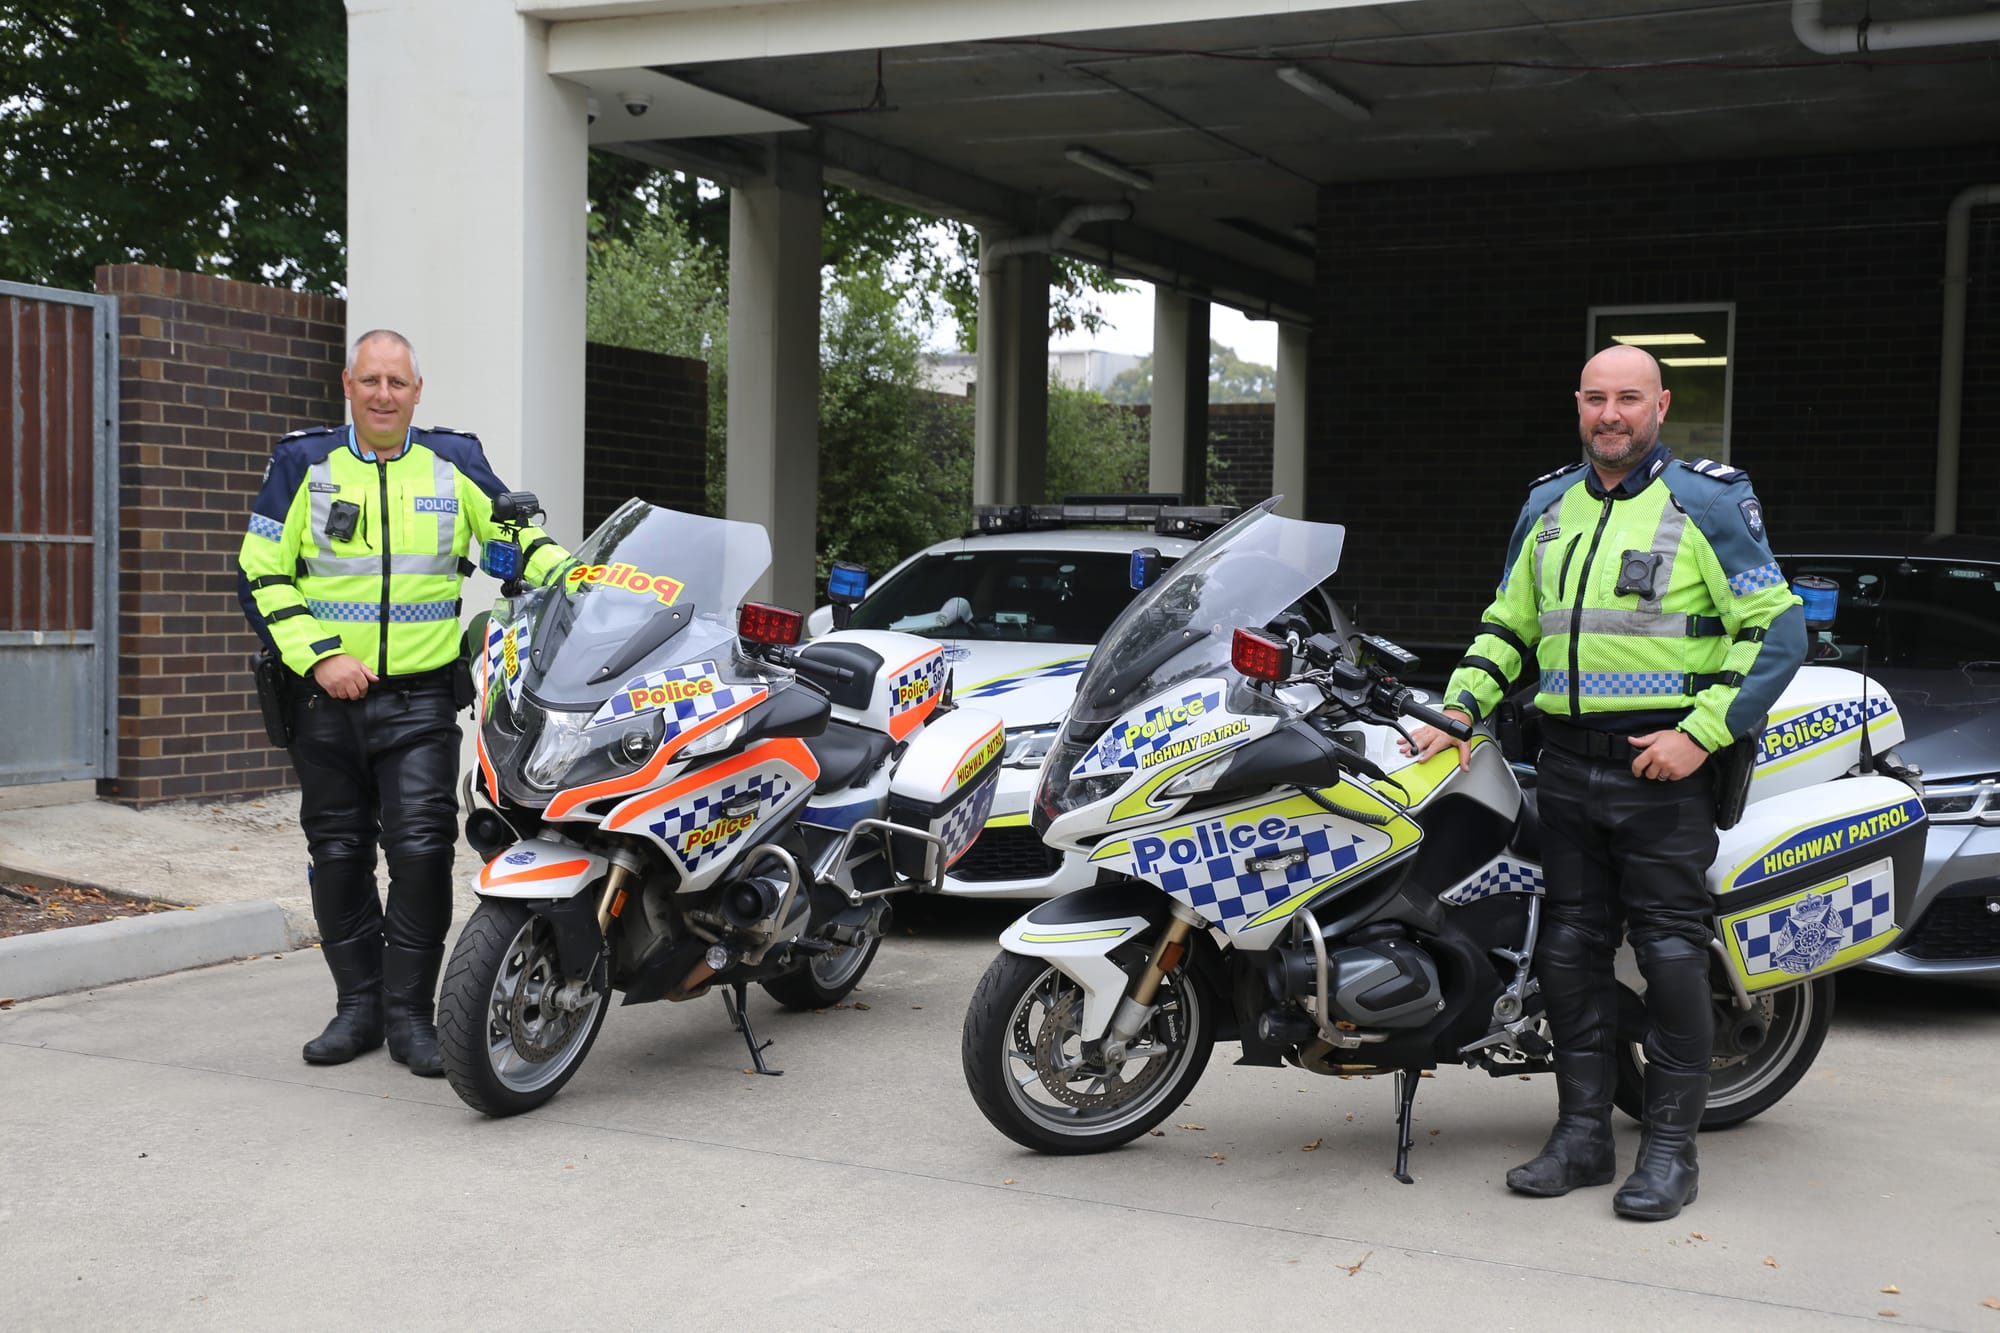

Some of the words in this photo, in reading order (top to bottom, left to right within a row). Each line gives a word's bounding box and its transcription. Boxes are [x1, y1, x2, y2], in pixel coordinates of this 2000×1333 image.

[416, 499, 457, 512] POLICE
[504, 627, 518, 677] Police
[631, 679, 714, 709] Police
[899, 679, 929, 703] Police
[1124, 697, 1205, 749] Police
[1765, 717, 1836, 755] Police
[1142, 736, 1199, 769] HIGHWAY
[1200, 718, 1250, 747] PATROL
[957, 750, 984, 787] HIGHWAY
[684, 814, 753, 852] Police
[1132, 818, 1286, 874] Police
[1764, 830, 1844, 875] HIGHWAY
[1848, 805, 1910, 844] PATROL
[1167, 1014, 1178, 1042] brembo
